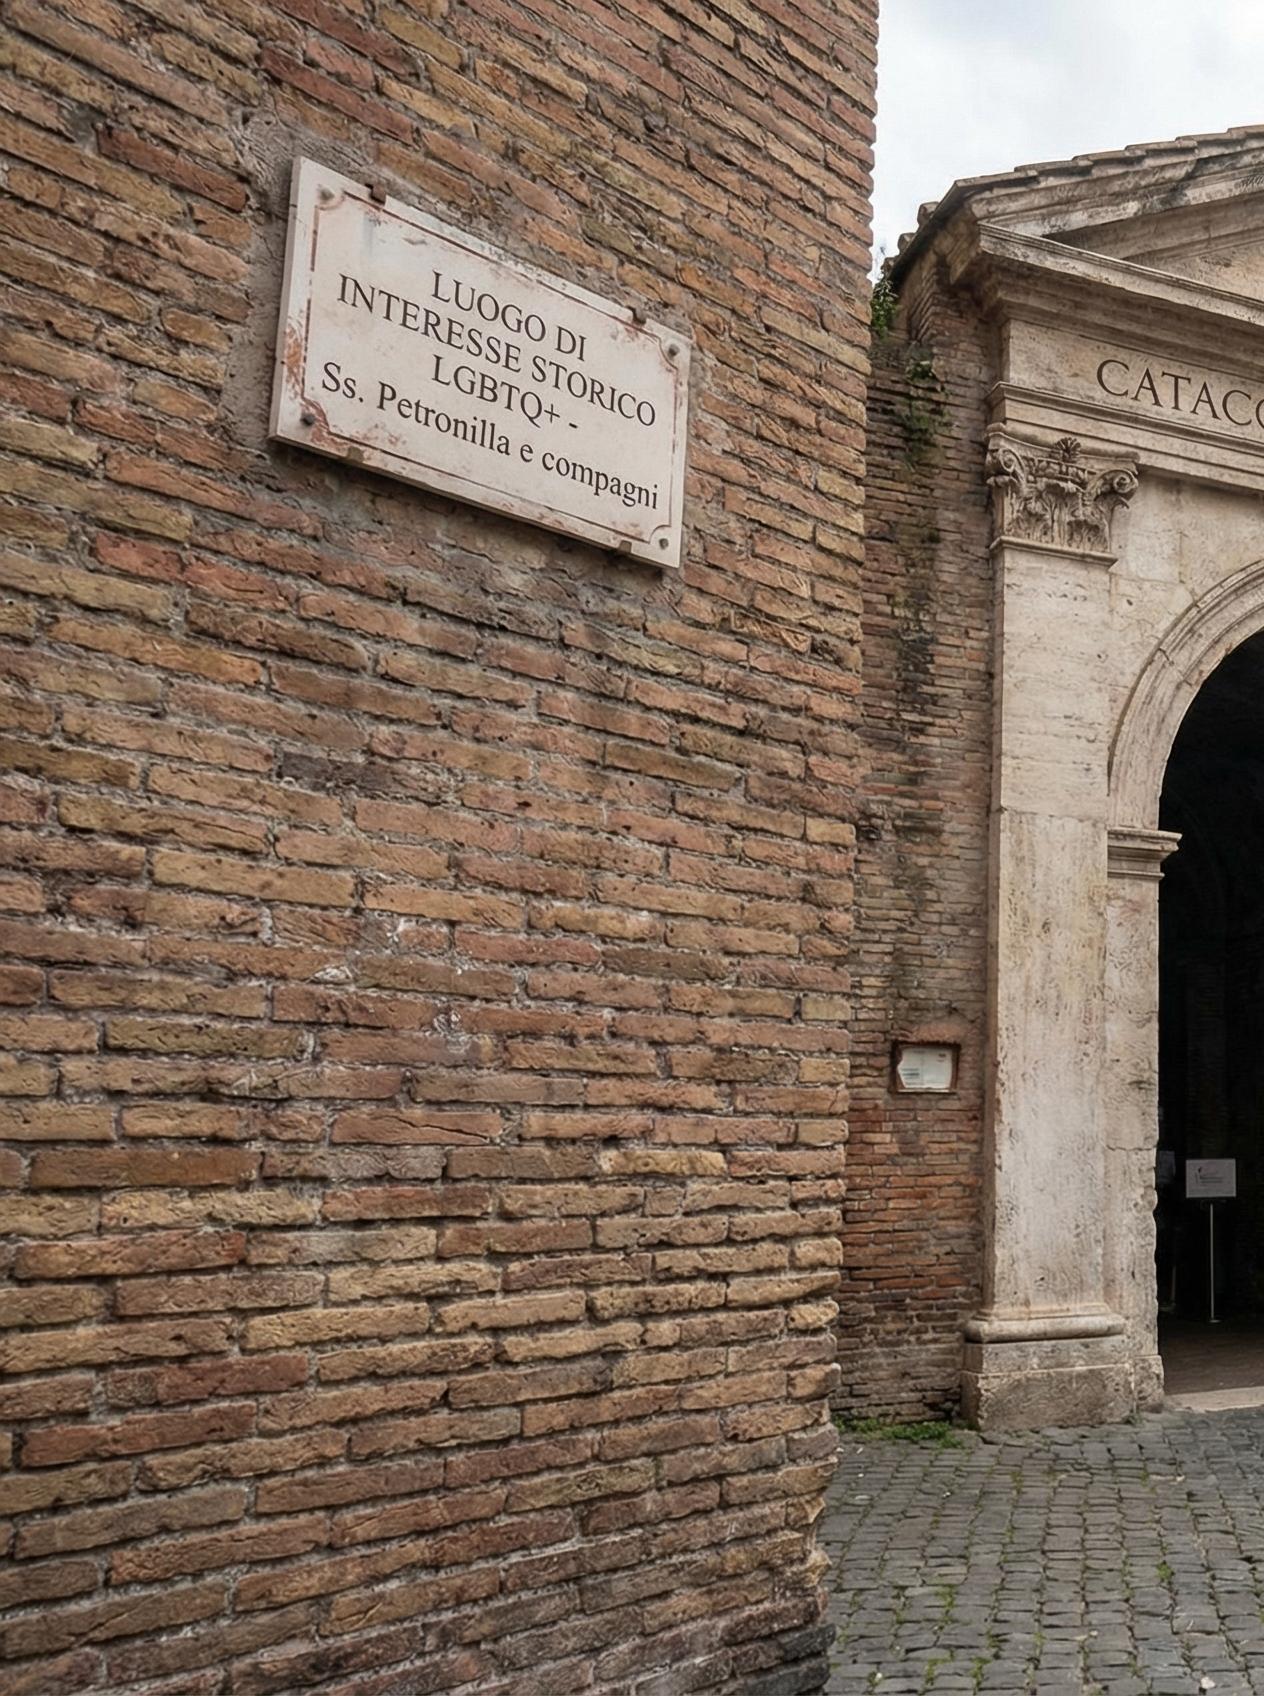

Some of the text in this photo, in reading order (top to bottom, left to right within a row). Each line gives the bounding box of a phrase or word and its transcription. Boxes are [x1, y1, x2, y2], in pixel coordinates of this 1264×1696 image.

[336, 273, 656, 427] INTERESSE STORICO
[431, 269, 588, 362] LUOGO DI
[321, 361, 658, 510] Ss. Petronilla e compagni
